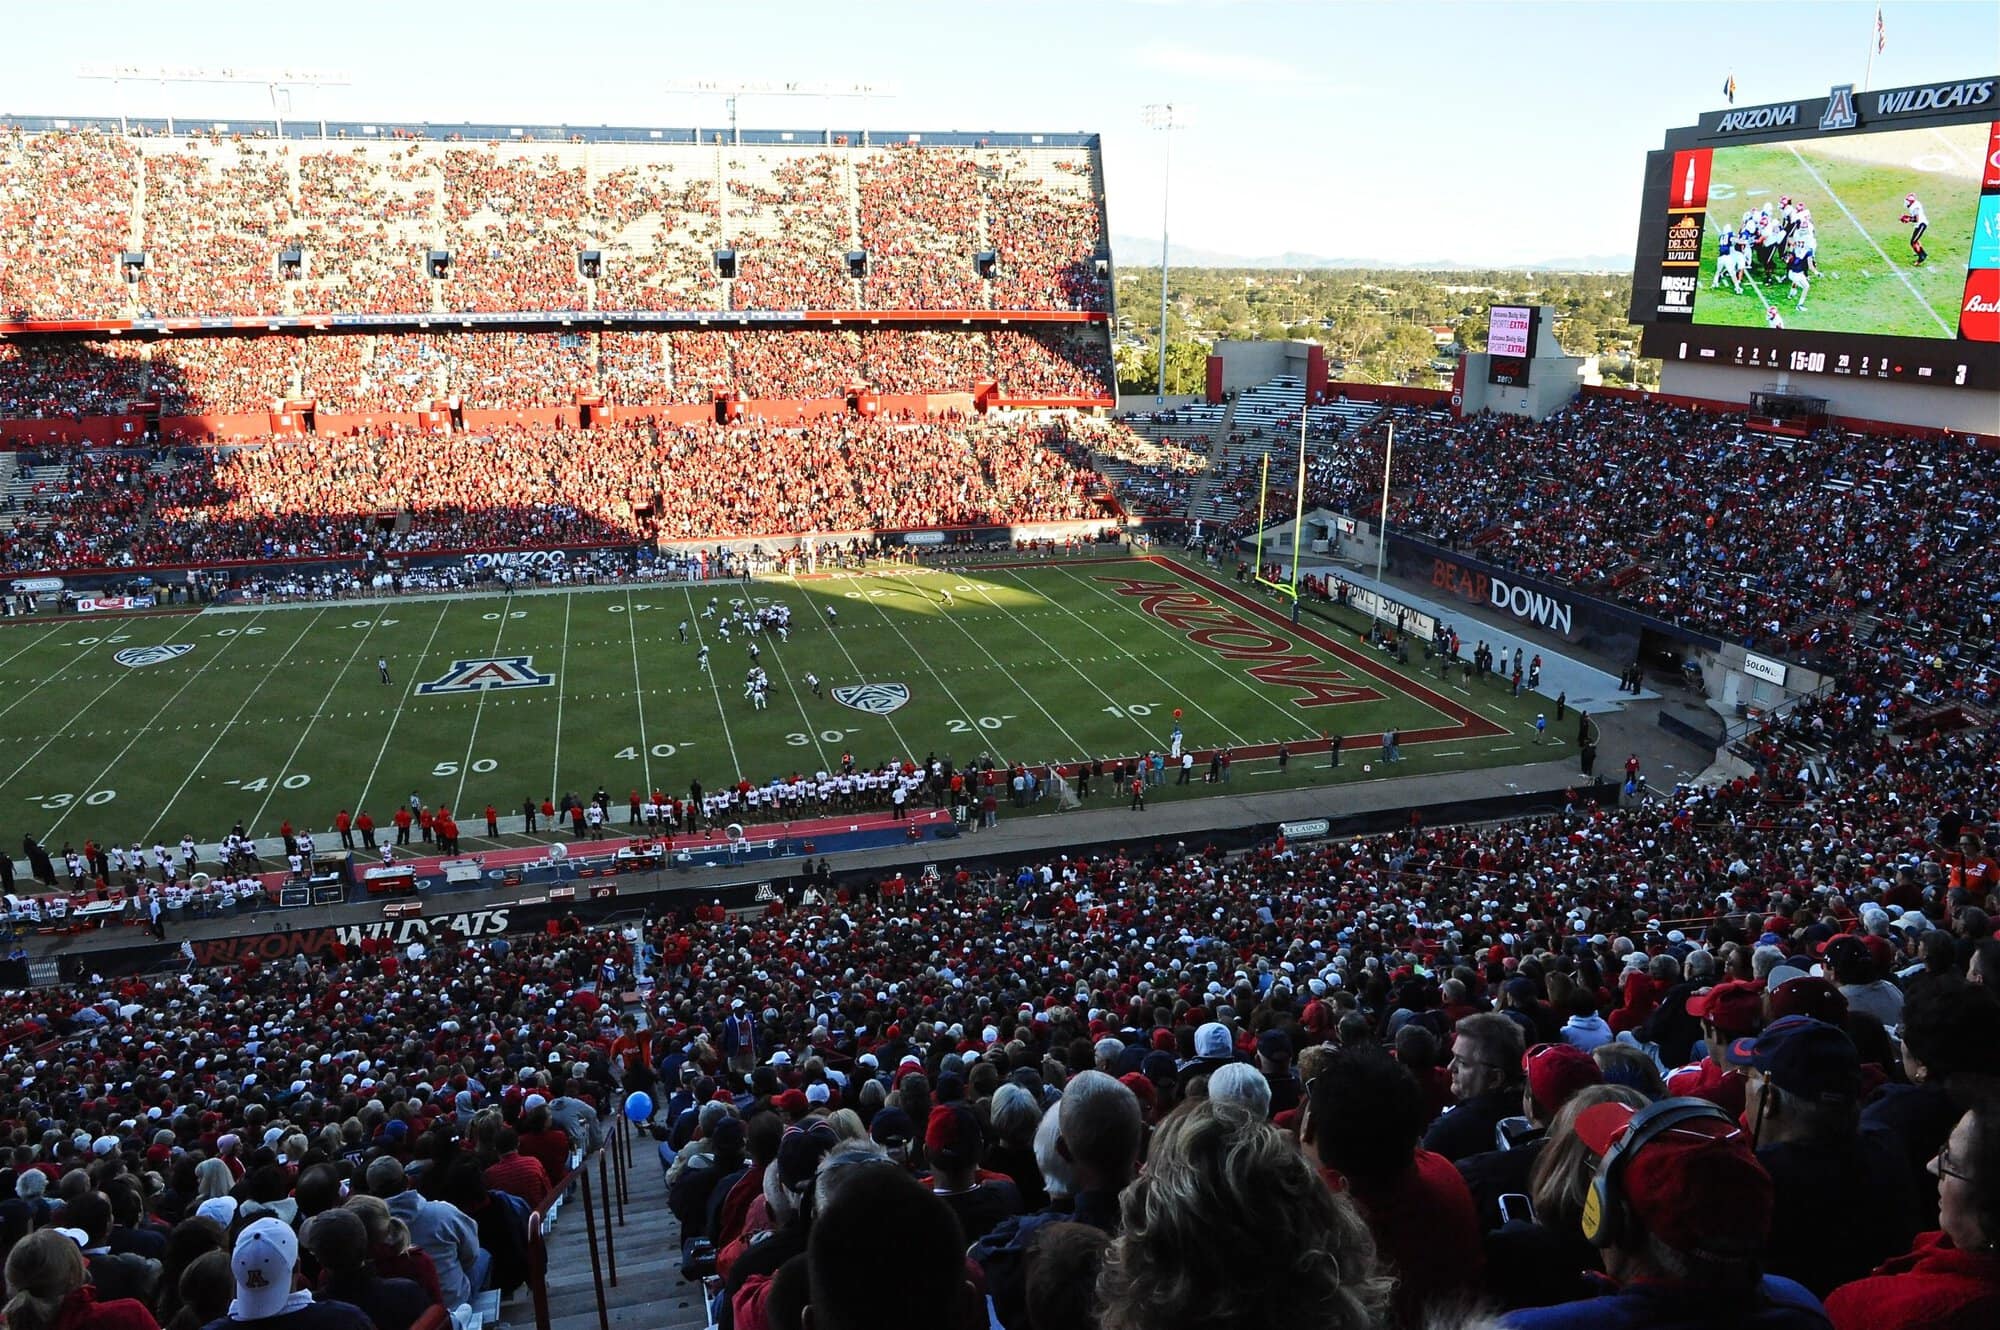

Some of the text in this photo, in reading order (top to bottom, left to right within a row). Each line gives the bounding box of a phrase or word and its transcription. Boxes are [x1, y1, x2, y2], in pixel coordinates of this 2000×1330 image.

[1877, 81, 1993, 114] WILDCATS
[1819, 83, 1857, 131] A
[1716, 104, 1797, 132] ARIZONA
[1669, 229, 1698, 239] CASINO
[1668, 240, 1698, 249] DEL SOL
[1668, 252, 1694, 260] 11/11/11
[1661, 276, 1696, 290] MUSCLE
[1665, 291, 1690, 305] MILK
[1510, 321, 1528, 329] EXTRA
[1508, 345, 1526, 353] EXTRA
[1737, 346, 1743, 358] 2
[1752, 348, 1759, 359] 2
[1790, 351, 1826, 372] 15:00
[1862, 357, 1869, 369] 2
[1955, 365, 1967, 385] 3
[1432, 559, 1572, 636] BEAR DOWN
[1089, 575, 1391, 708] ARIZONA
[414, 655, 556, 696] A
[1746, 660, 1771, 676] SOLON
[1102, 704, 1152, 718] 10
[946, 716, 1003, 733] 20
[785, 730, 844, 746] 30
[614, 743, 677, 761] 40
[432, 758, 498, 776] 50
[241, 774, 312, 792] 40
[41, 790, 117, 809] 30
[755, 882, 776, 901] A
[193, 928, 337, 966] ARIZONA
